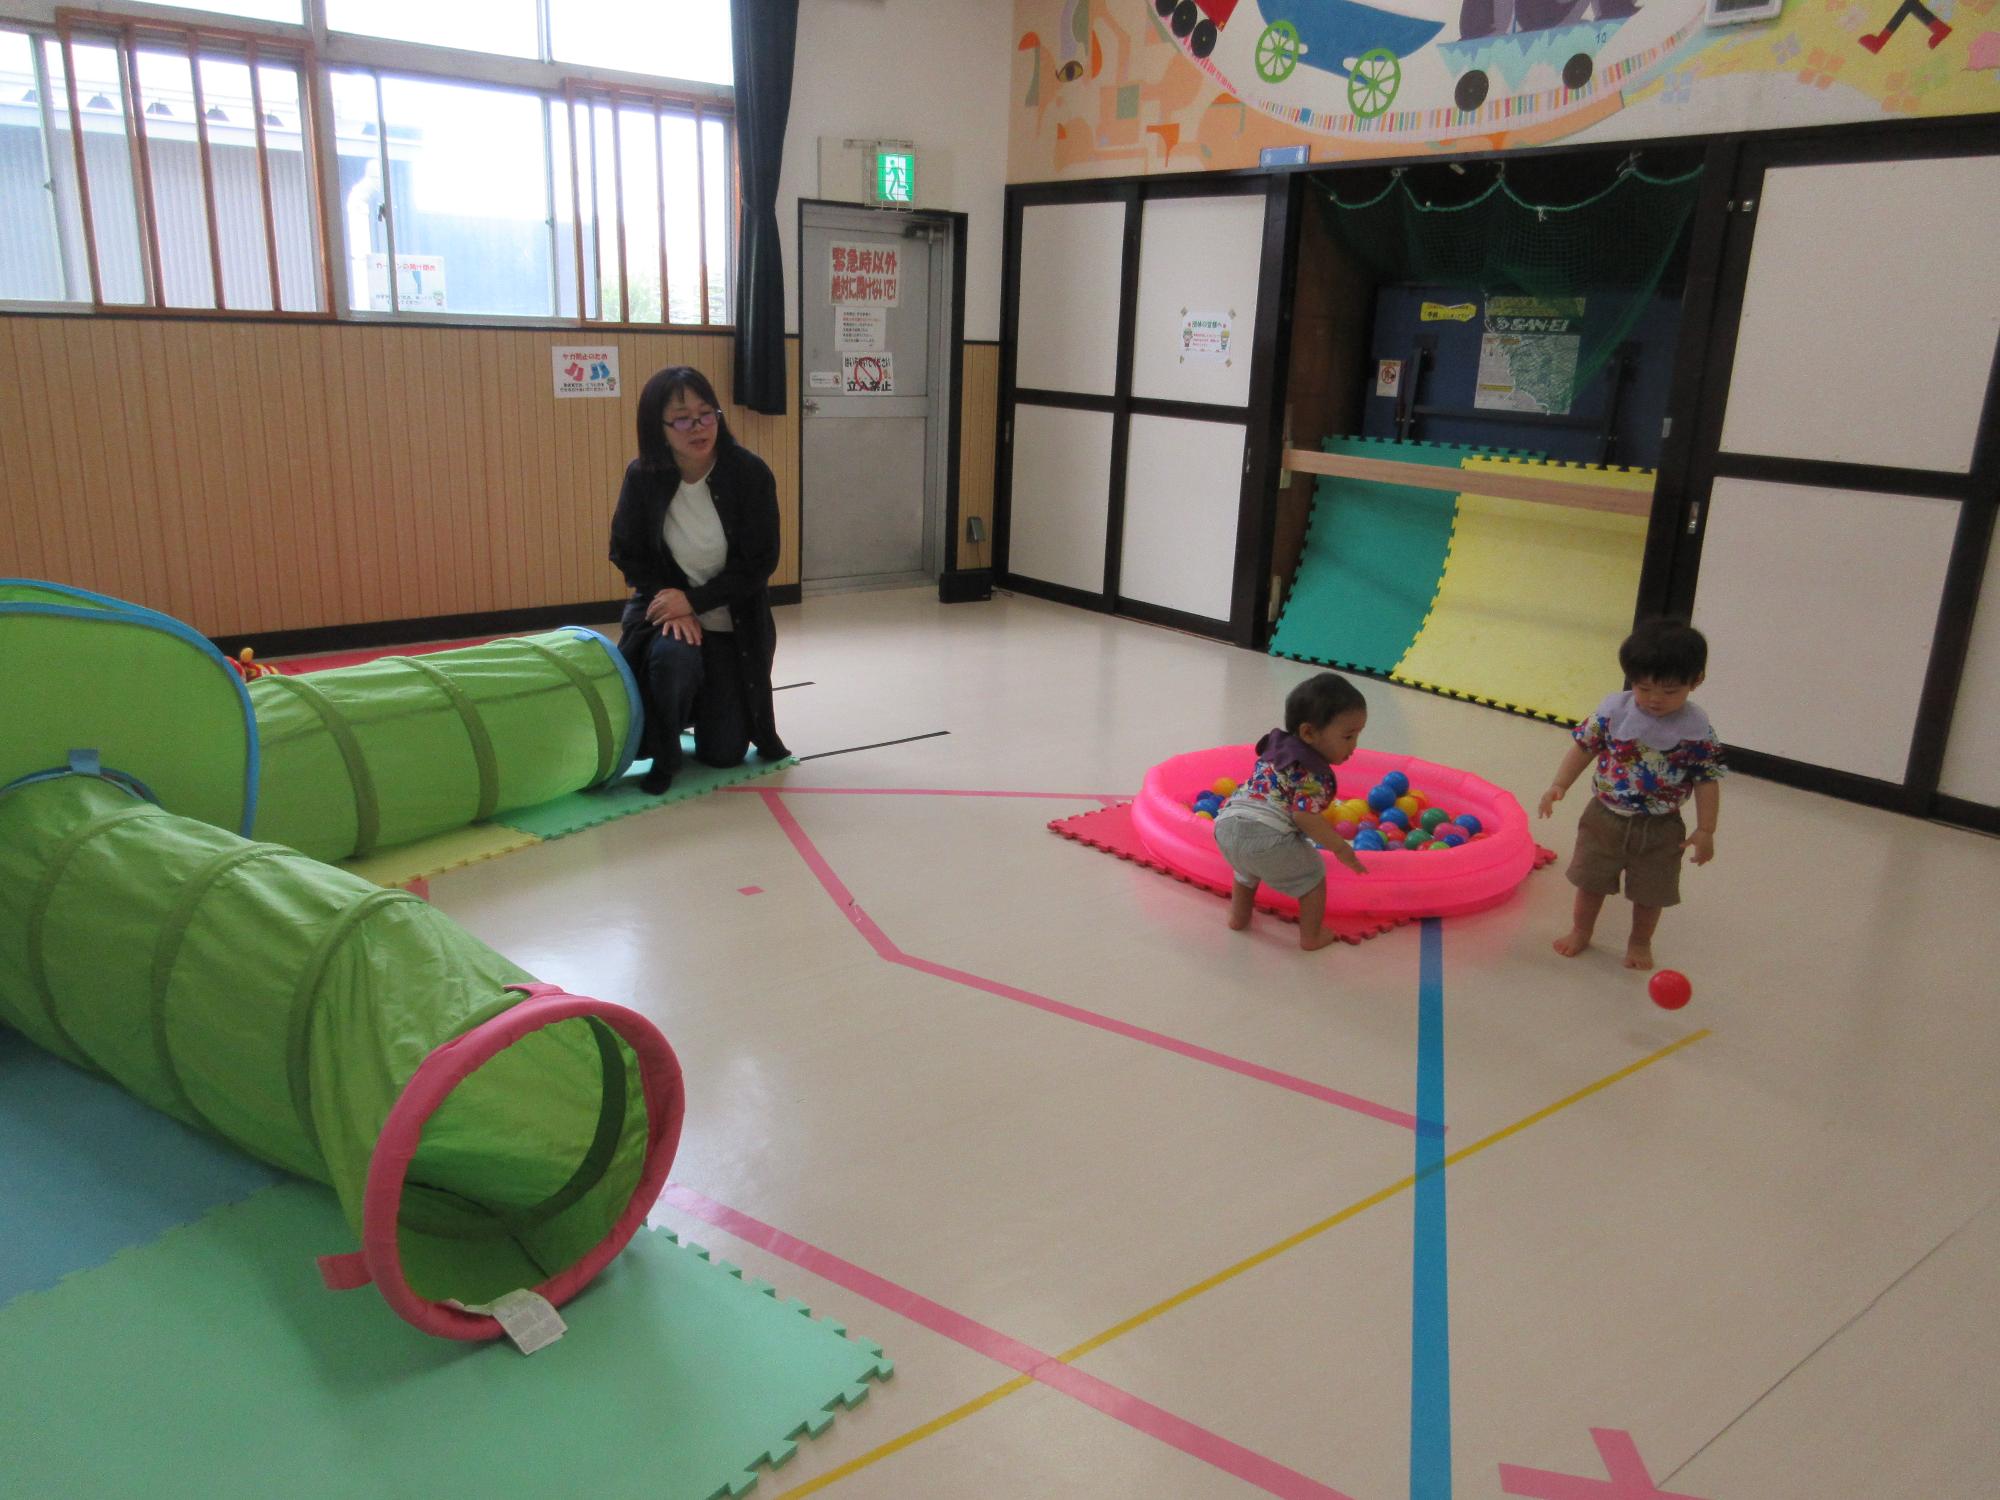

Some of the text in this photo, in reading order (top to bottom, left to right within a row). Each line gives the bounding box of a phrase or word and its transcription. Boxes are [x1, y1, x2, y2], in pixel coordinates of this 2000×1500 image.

[1595, 32, 1607, 45] 10
[831, 247, 897, 275] 緊急時以外
[376, 263, 436, 272] カーンの開け閉め
[563, 352, 608, 361] ケガ防止のため
[847, 380, 892, 392] 立入禁止
